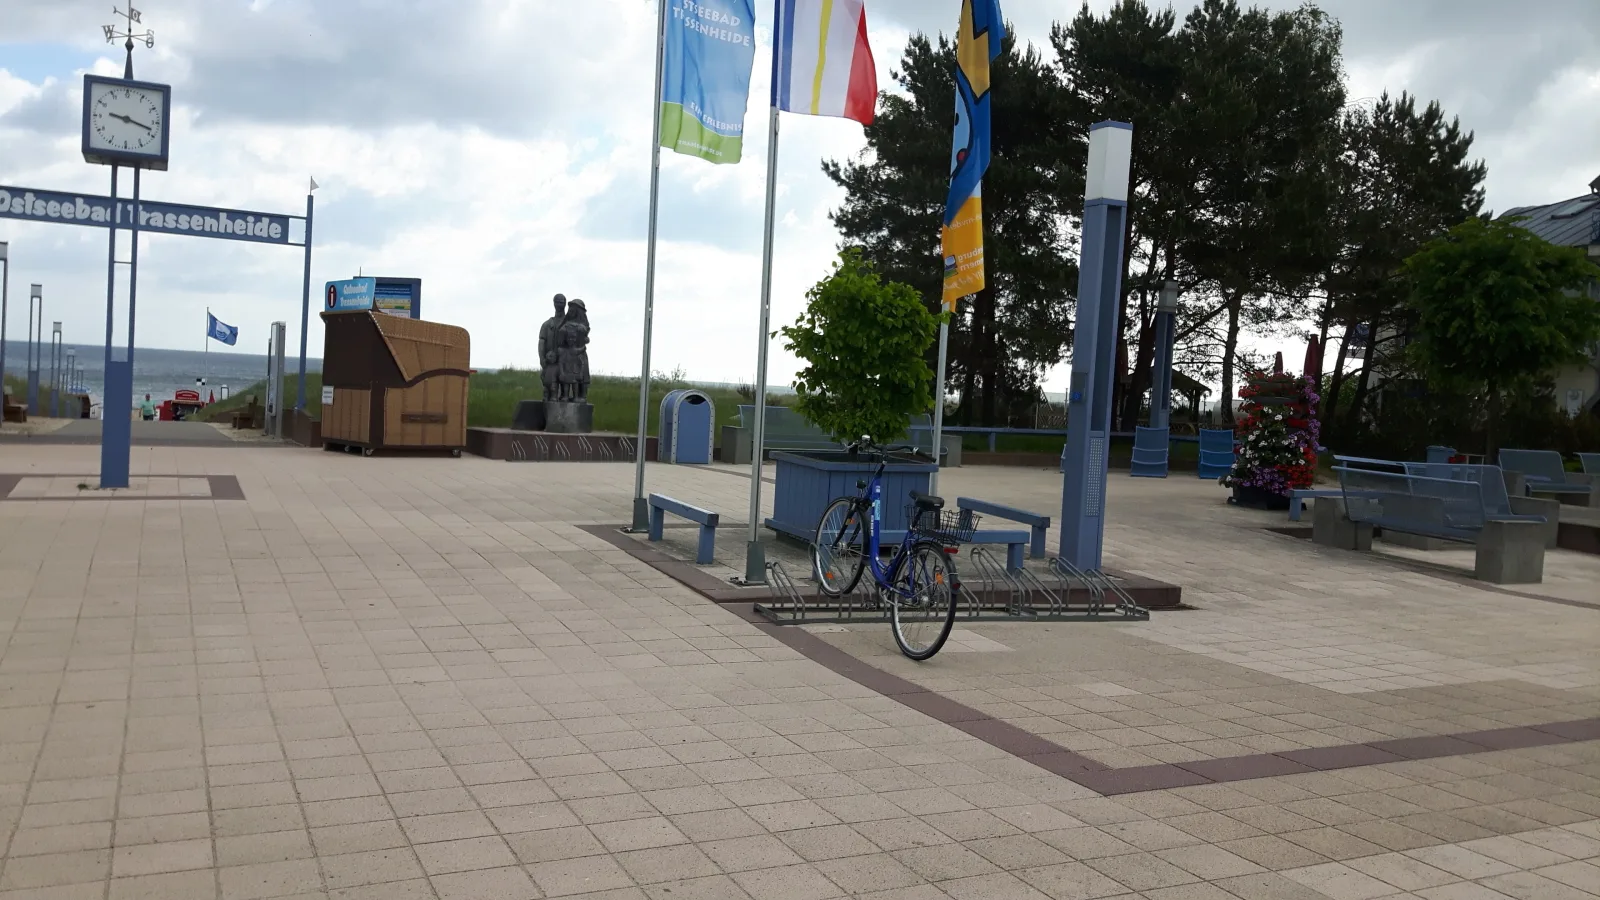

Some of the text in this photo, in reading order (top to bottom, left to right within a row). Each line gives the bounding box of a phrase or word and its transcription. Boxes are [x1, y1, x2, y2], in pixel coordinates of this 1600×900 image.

[672, 6, 750, 47] TSSENHEIDE
[683, 0, 741, 27] STSEEBAD
[0, 189, 282, 239] Ostseebad Trassenheide
